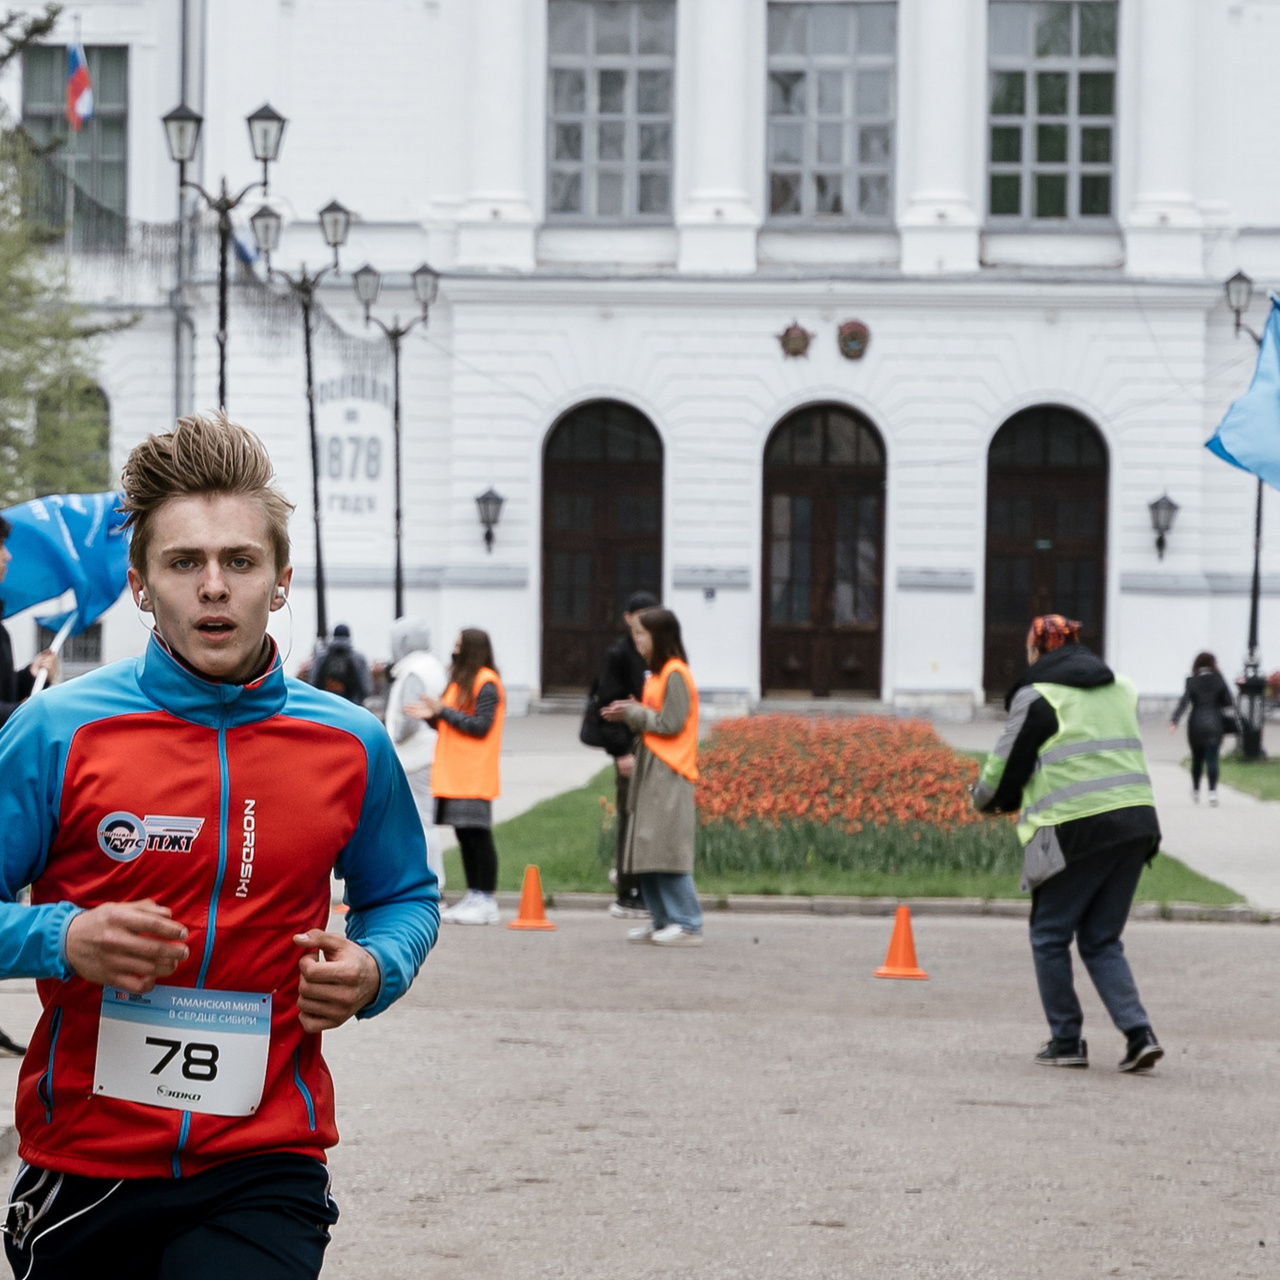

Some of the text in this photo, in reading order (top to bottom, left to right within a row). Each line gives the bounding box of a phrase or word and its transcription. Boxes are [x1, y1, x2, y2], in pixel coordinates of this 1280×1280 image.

[234, 799, 256, 898] NORDSKI
[168, 1009, 258, 1025] В СЕРДЦЕ СИБИРИ
[170, 996, 260, 1012] ТАМАНСКАЯ МИЛЯ
[145, 1036, 220, 1081] 78
